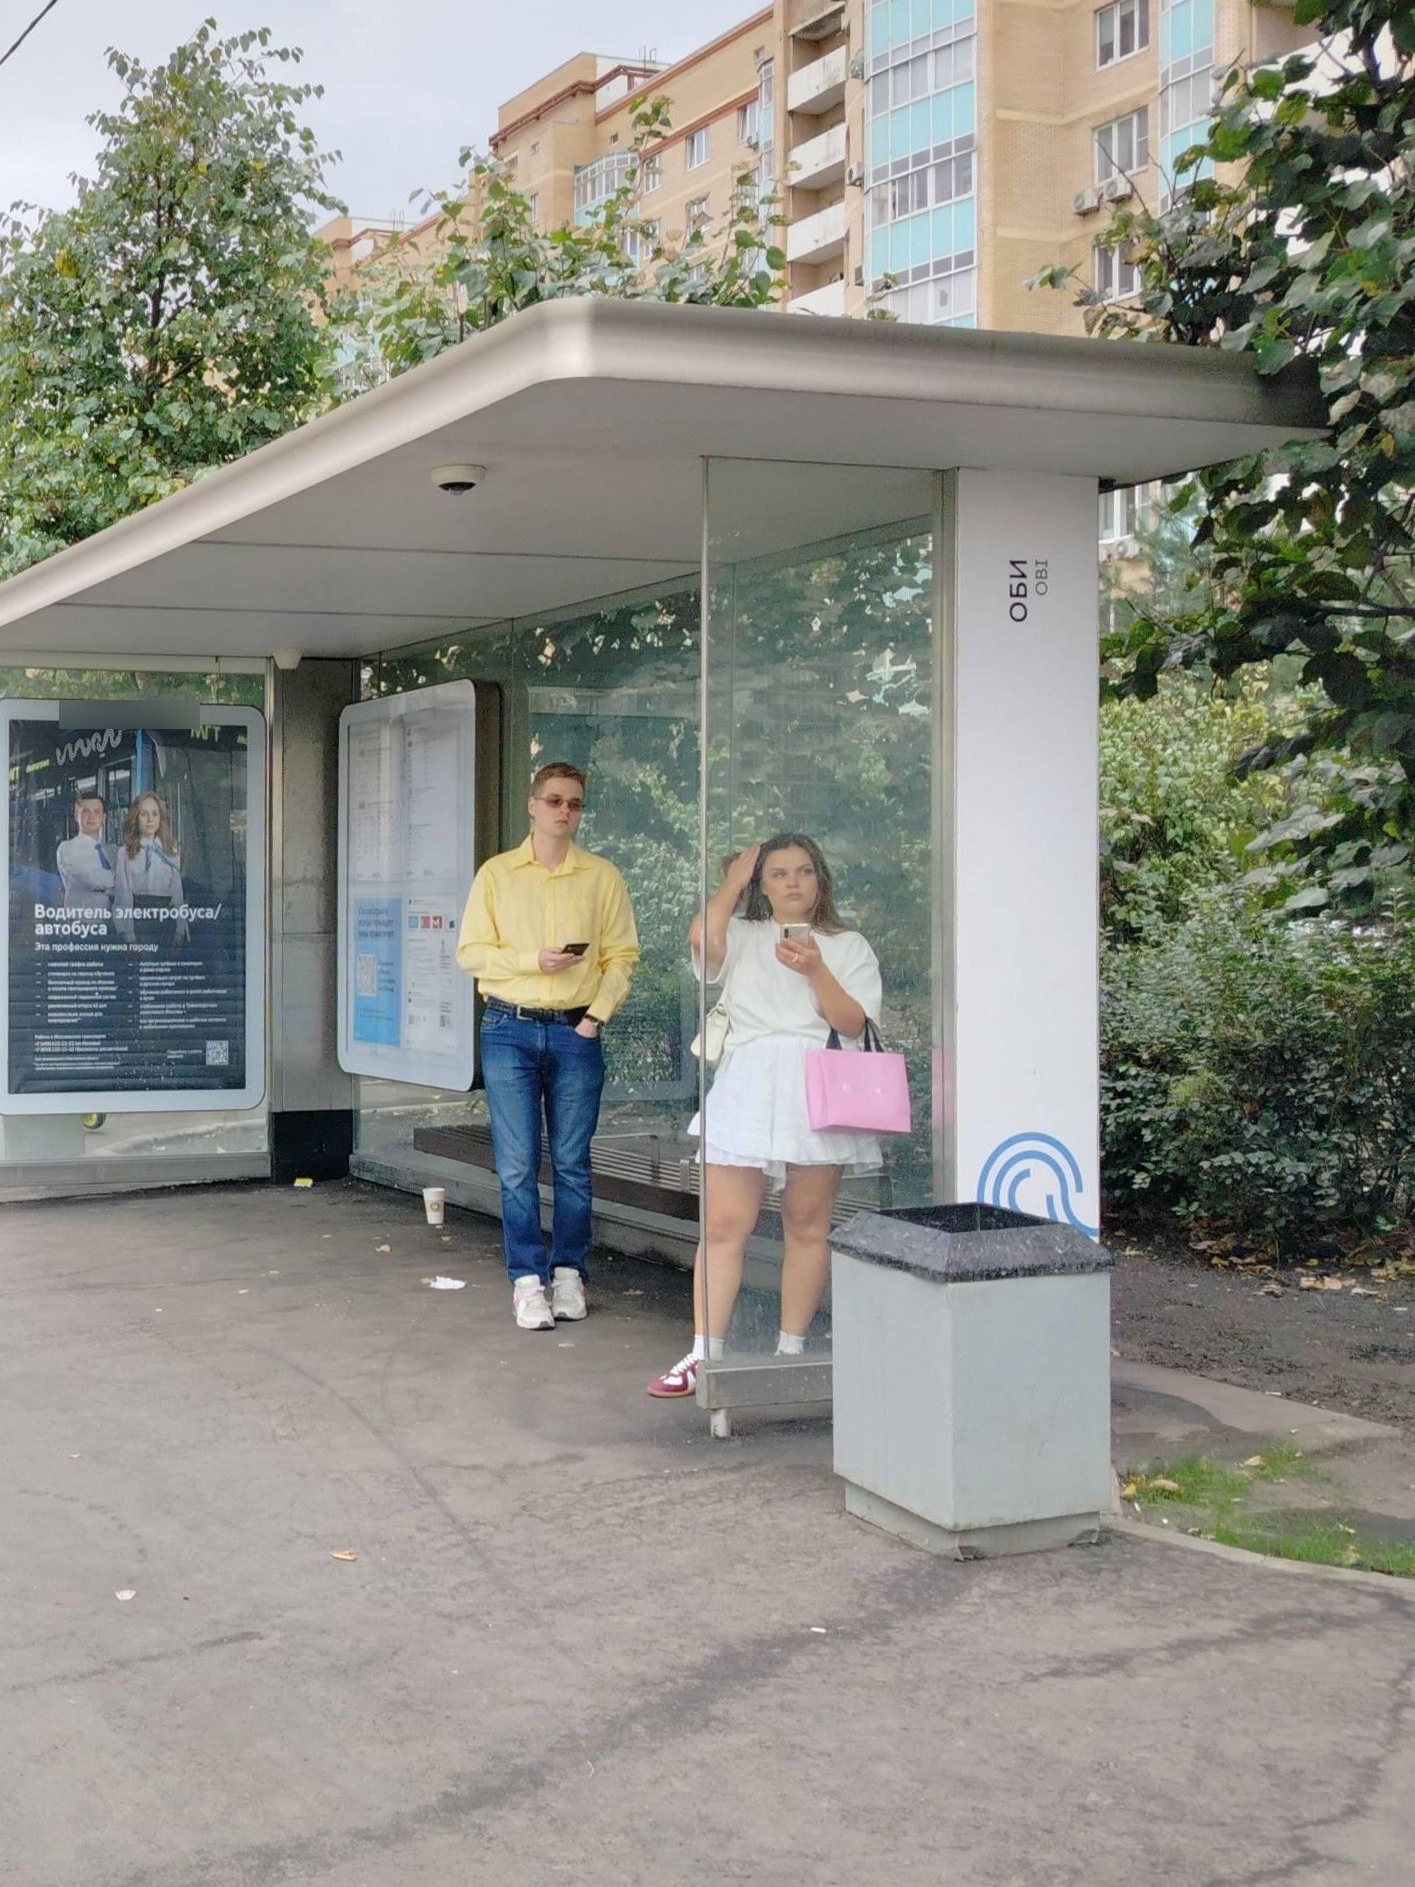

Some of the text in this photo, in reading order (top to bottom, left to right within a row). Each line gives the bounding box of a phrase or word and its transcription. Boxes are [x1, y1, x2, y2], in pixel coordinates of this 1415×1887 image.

[1035, 560, 1048, 595] OBI
[1009, 560, 1027, 622] ОБИ
[35, 903, 221, 922] Водитель электробуса/
[34, 920, 108, 938] автобуса
[34, 942, 159, 953] Эта профессия нужна городу
